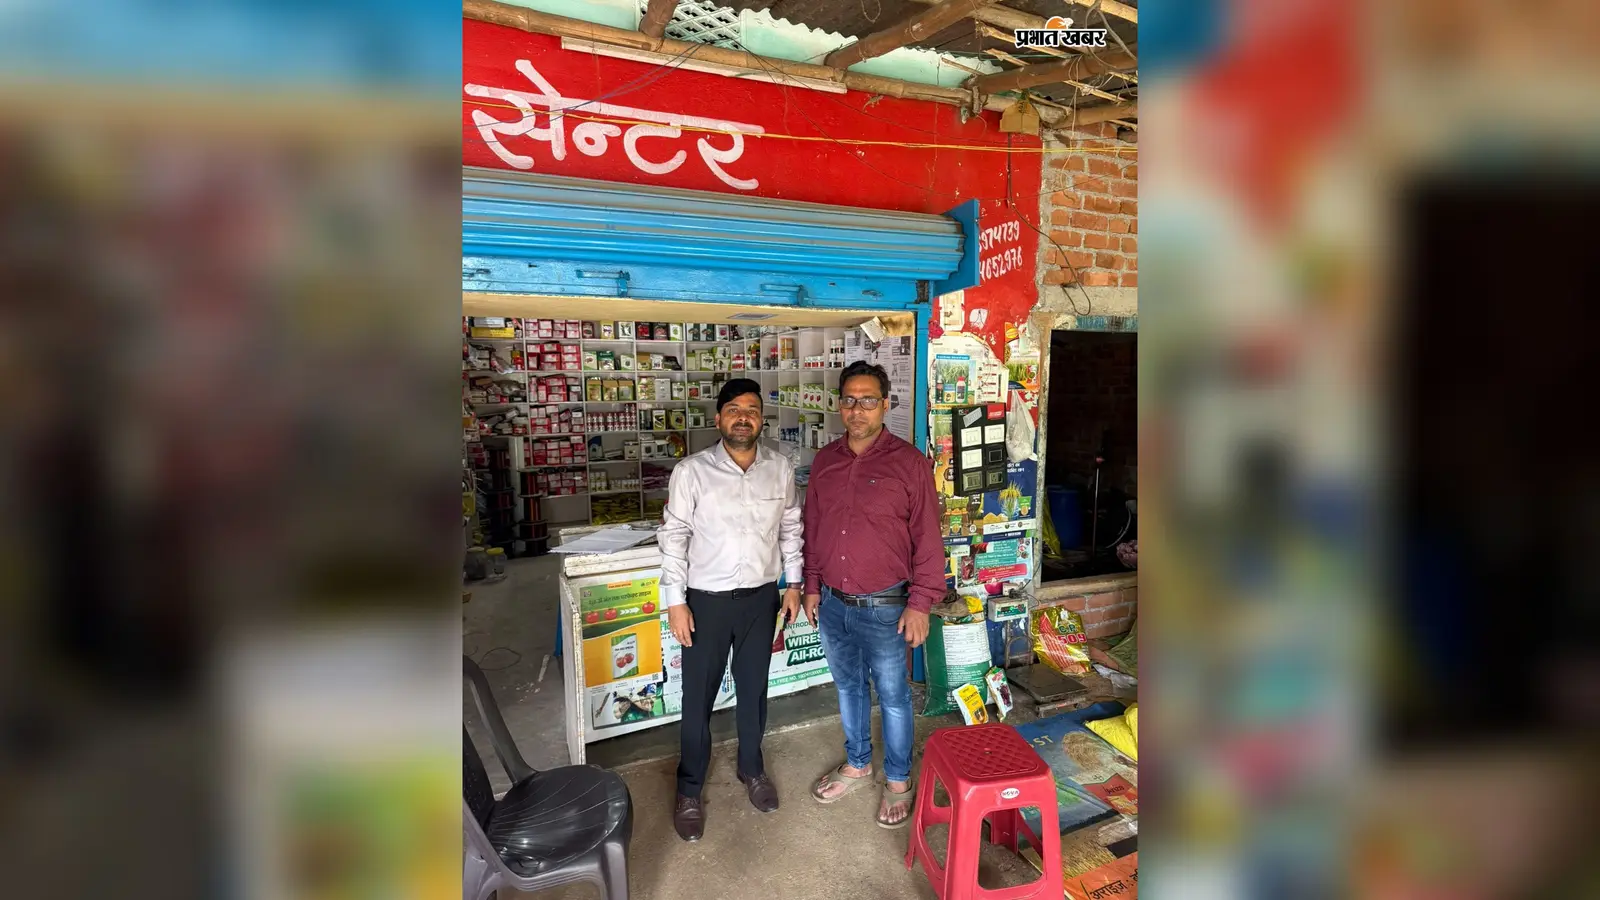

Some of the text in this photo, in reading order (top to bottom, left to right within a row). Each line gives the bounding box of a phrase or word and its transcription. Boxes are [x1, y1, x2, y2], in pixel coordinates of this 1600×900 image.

[464, 59, 765, 190] सेन्टर
[1057, 633, 1087, 645] 509
[1029, 734, 1053, 748] ST
